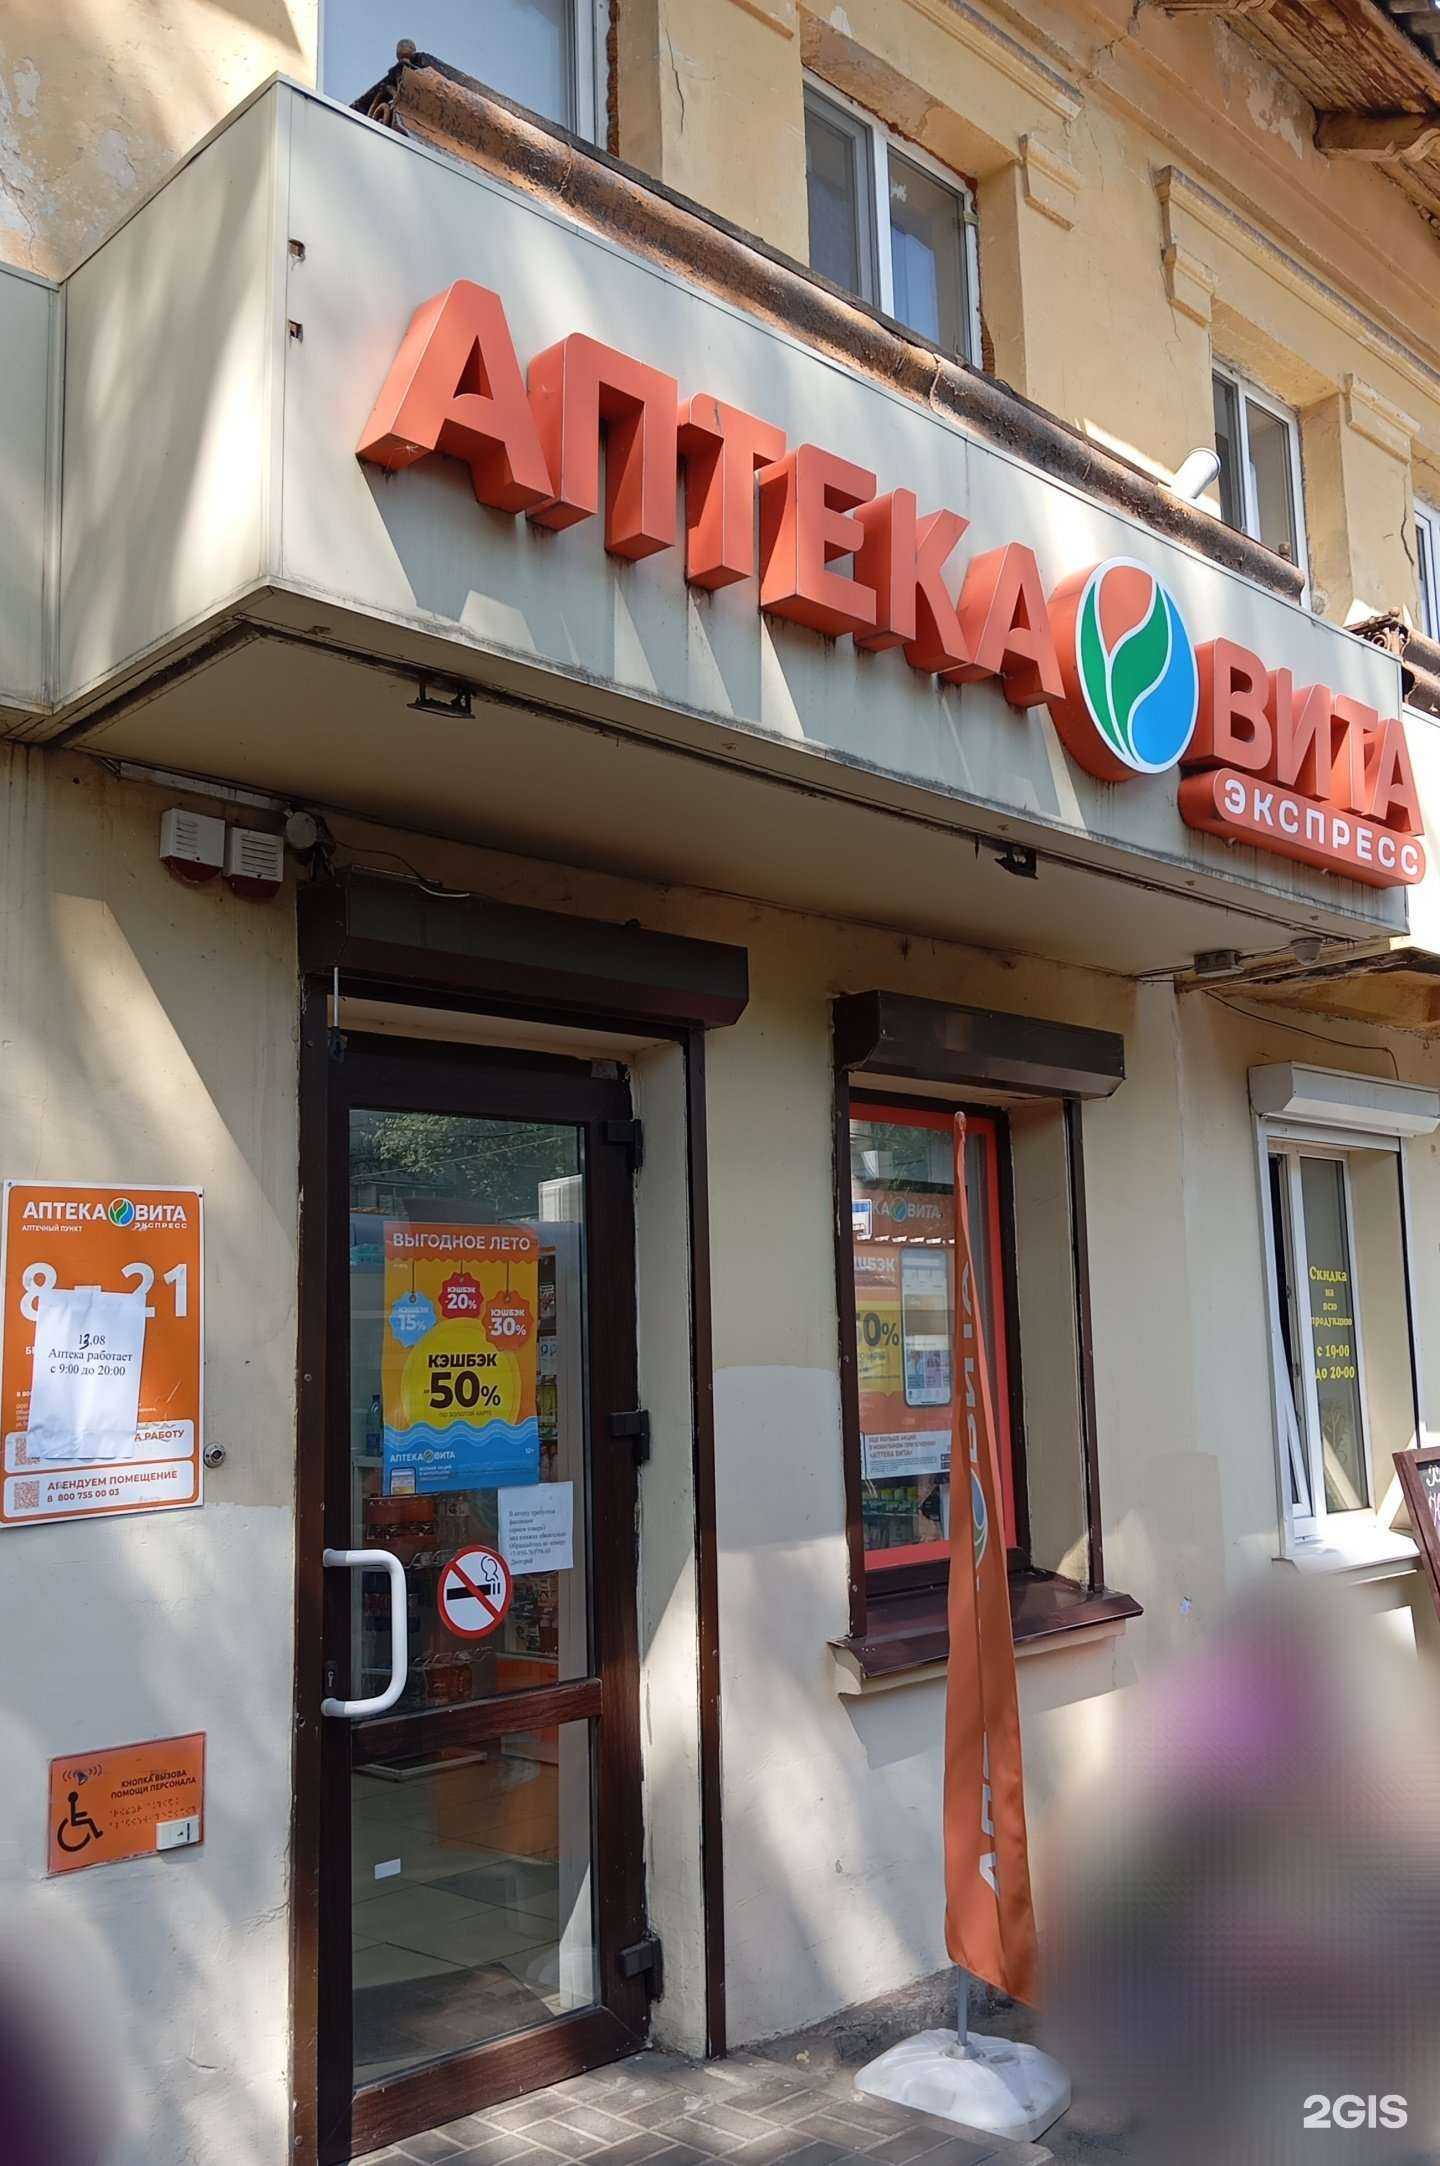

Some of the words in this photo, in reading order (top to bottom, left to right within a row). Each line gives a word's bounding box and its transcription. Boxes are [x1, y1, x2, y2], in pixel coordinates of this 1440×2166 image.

[356, 280, 1065, 707] АПТЕКА
[1190, 637, 1425, 836] ВИТА
[1223, 778, 1419, 877] ЭКСПРЕСС
[22, 1201, 108, 1221] АПТЕКА
[135, 1205, 187, 1222] ВИТА
[60, 1225, 83, 1233] ПУНКТ
[134, 1222, 188, 1230] ЭКСПРЕСС
[393, 1232, 486, 1251] ВЫГОДНОЕ
[489, 1236, 531, 1251] ЛЕТО
[1309, 1266, 1348, 1282] Скидка
[48, 1349, 84, 1360] Аптека
[87, 1350, 133, 1363] работает
[428, 1353, 497, 1369] КЭШБЭК
[59, 1364, 79, 1374] 9:00
[81, 1366, 95, 1376] до
[97, 1366, 126, 1377] 20:00
[429, 1370, 501, 1409] 50%
[144, 1430, 185, 1441] РАБОТУ
[389, 1454, 423, 1463] АПТЕКА
[109, 1470, 178, 1486] ПОМЕЩЕНИЕ
[57, 1491, 75, 1502] 800
[78, 1490, 93, 1499] 755
[95, 1489, 107, 1498] 00
[121, 1775, 153, 1788] КНОПКА
[154, 1769, 187, 1783] ВЫЗОВА
[111, 1785, 149, 1799] ПОМОЩИ
[150, 1776, 196, 1792] ПЕРСОНАЛА
